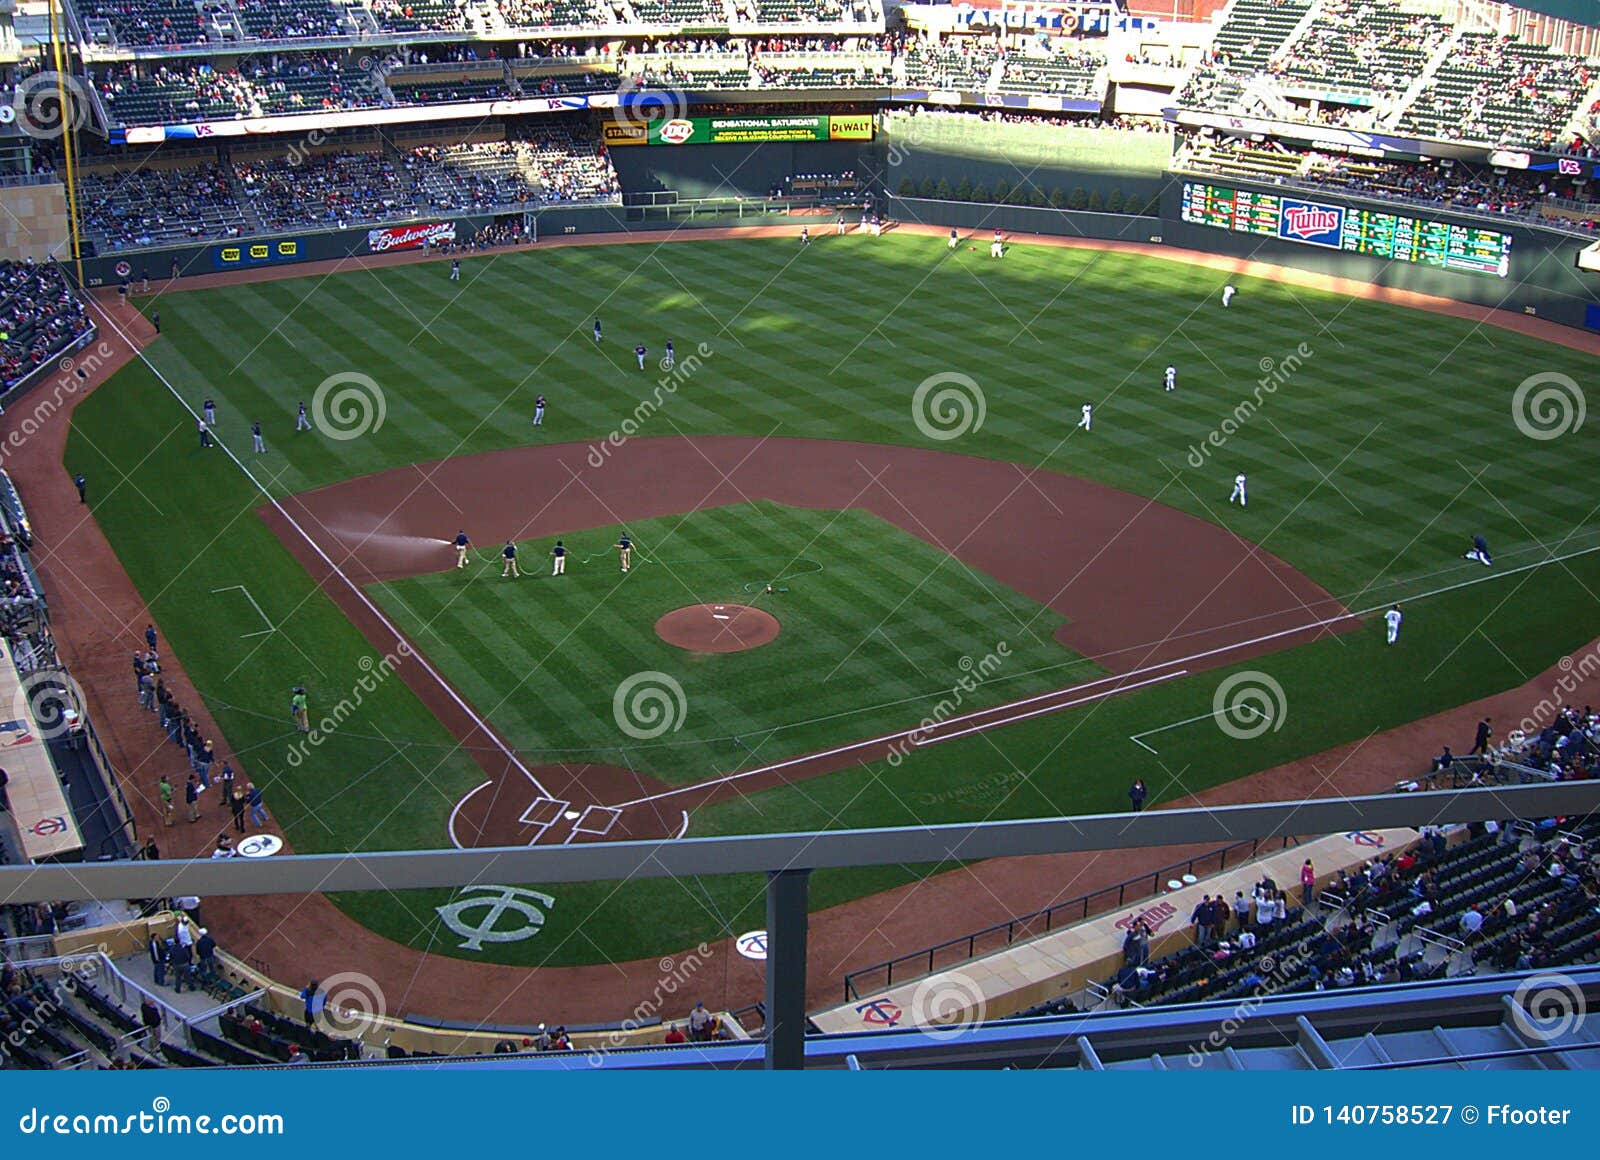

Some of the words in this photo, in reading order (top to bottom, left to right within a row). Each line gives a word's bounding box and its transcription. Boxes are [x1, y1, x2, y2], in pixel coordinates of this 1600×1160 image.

[956, 8, 1057, 28] TARGET
[1083, 11, 1159, 32] FIELD
[607, 128, 642, 137] STANLEY
[712, 120, 770, 128] SENSATIONAL
[771, 118, 818, 126] SATURDAYS
[1285, 206, 1338, 237] Twins
[378, 221, 451, 250] Budweiser
